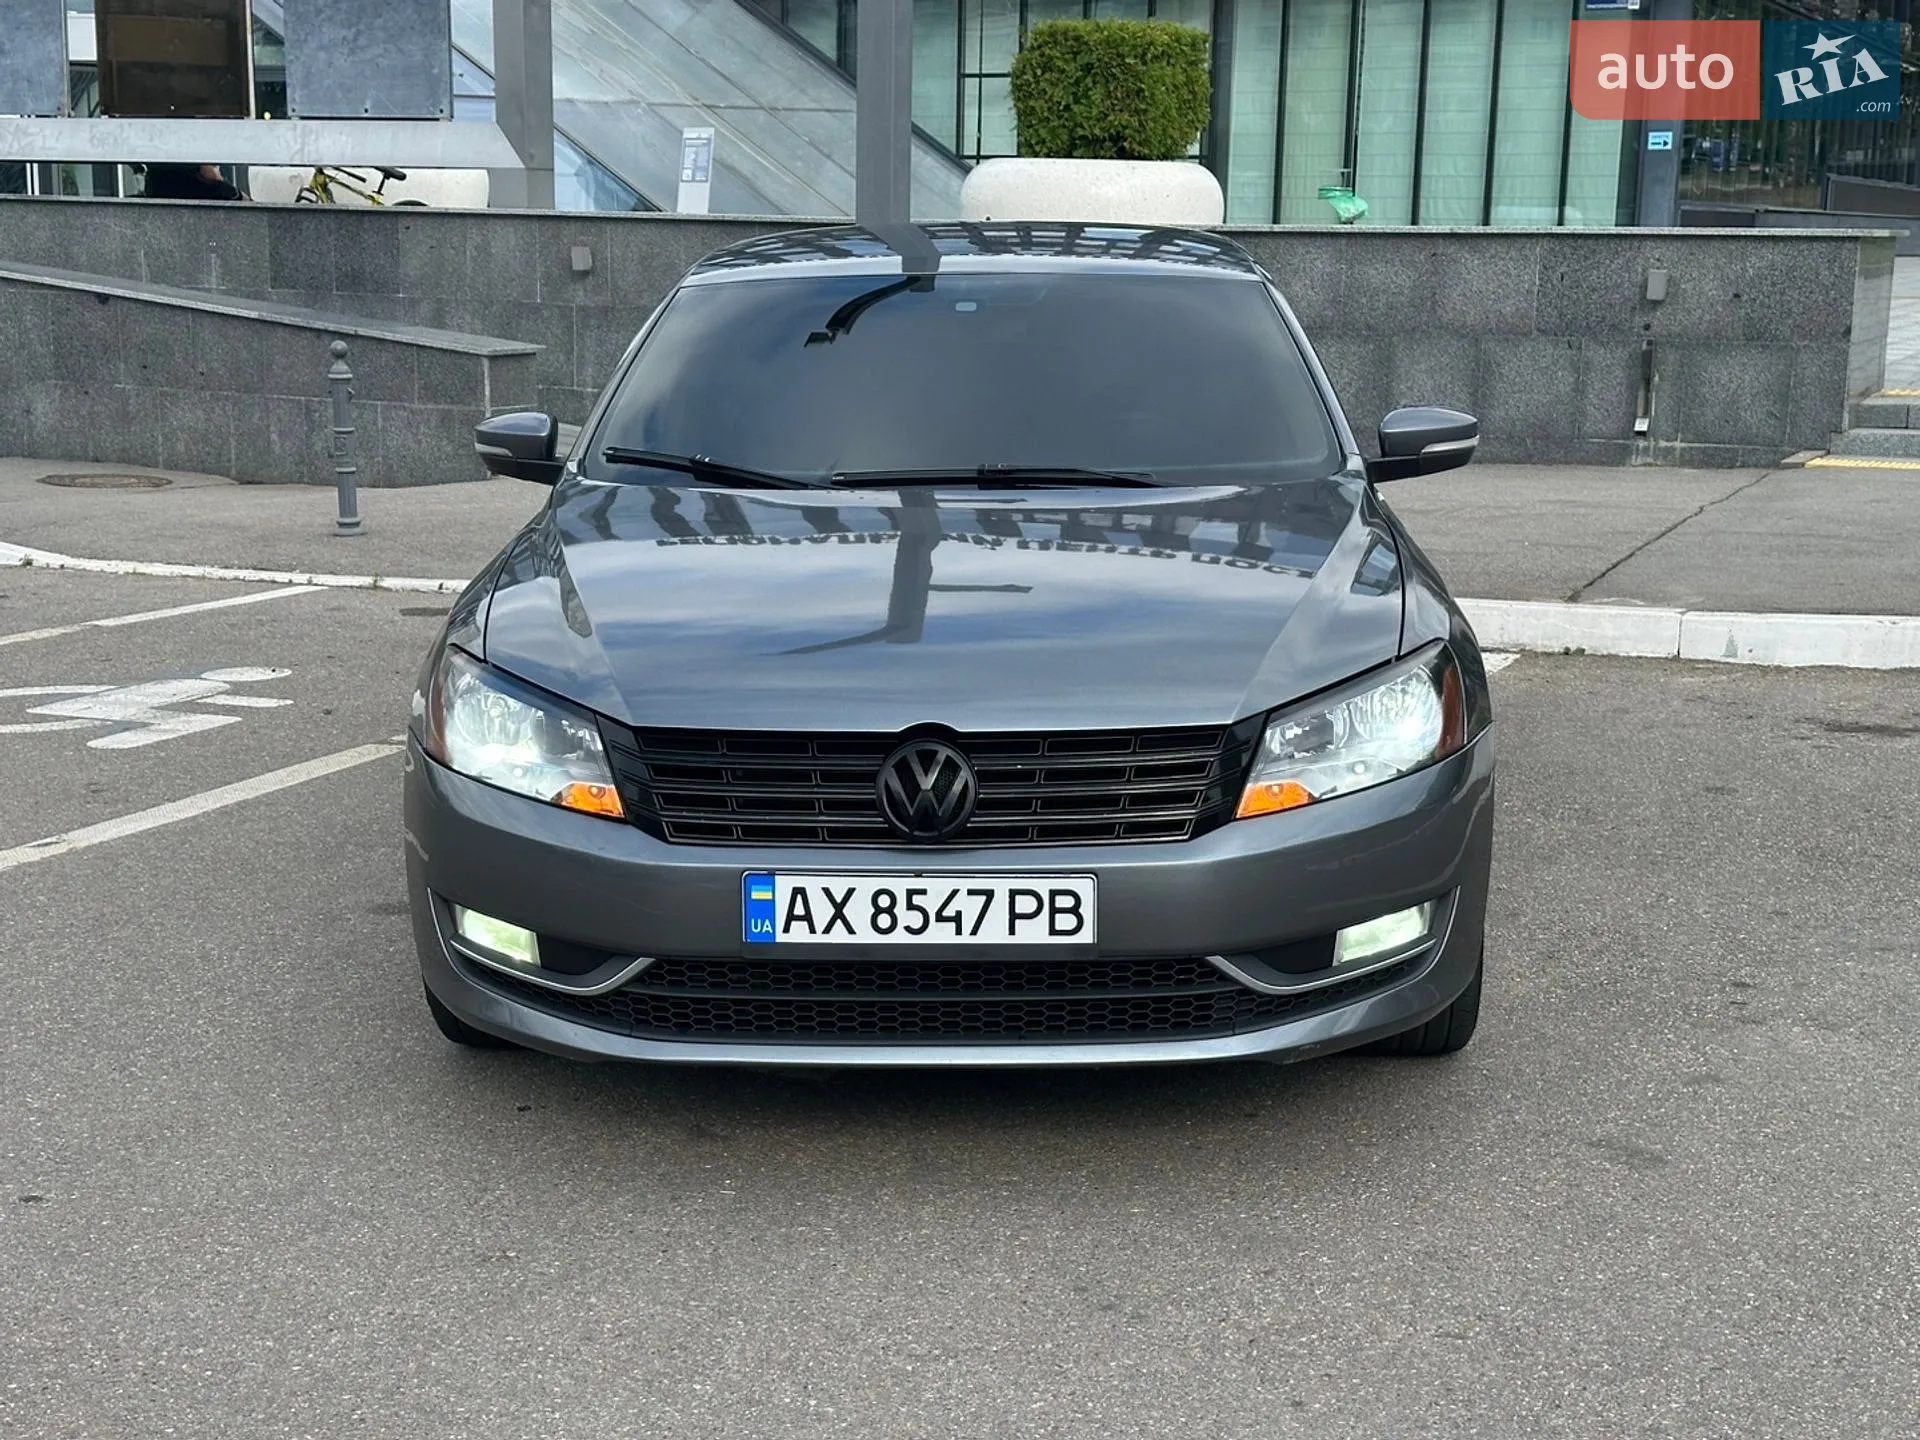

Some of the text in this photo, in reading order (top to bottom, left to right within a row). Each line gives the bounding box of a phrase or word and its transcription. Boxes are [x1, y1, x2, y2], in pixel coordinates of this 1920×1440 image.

[751, 918, 773, 934] UA
[782, 887, 1085, 936] AX 8547 PB
